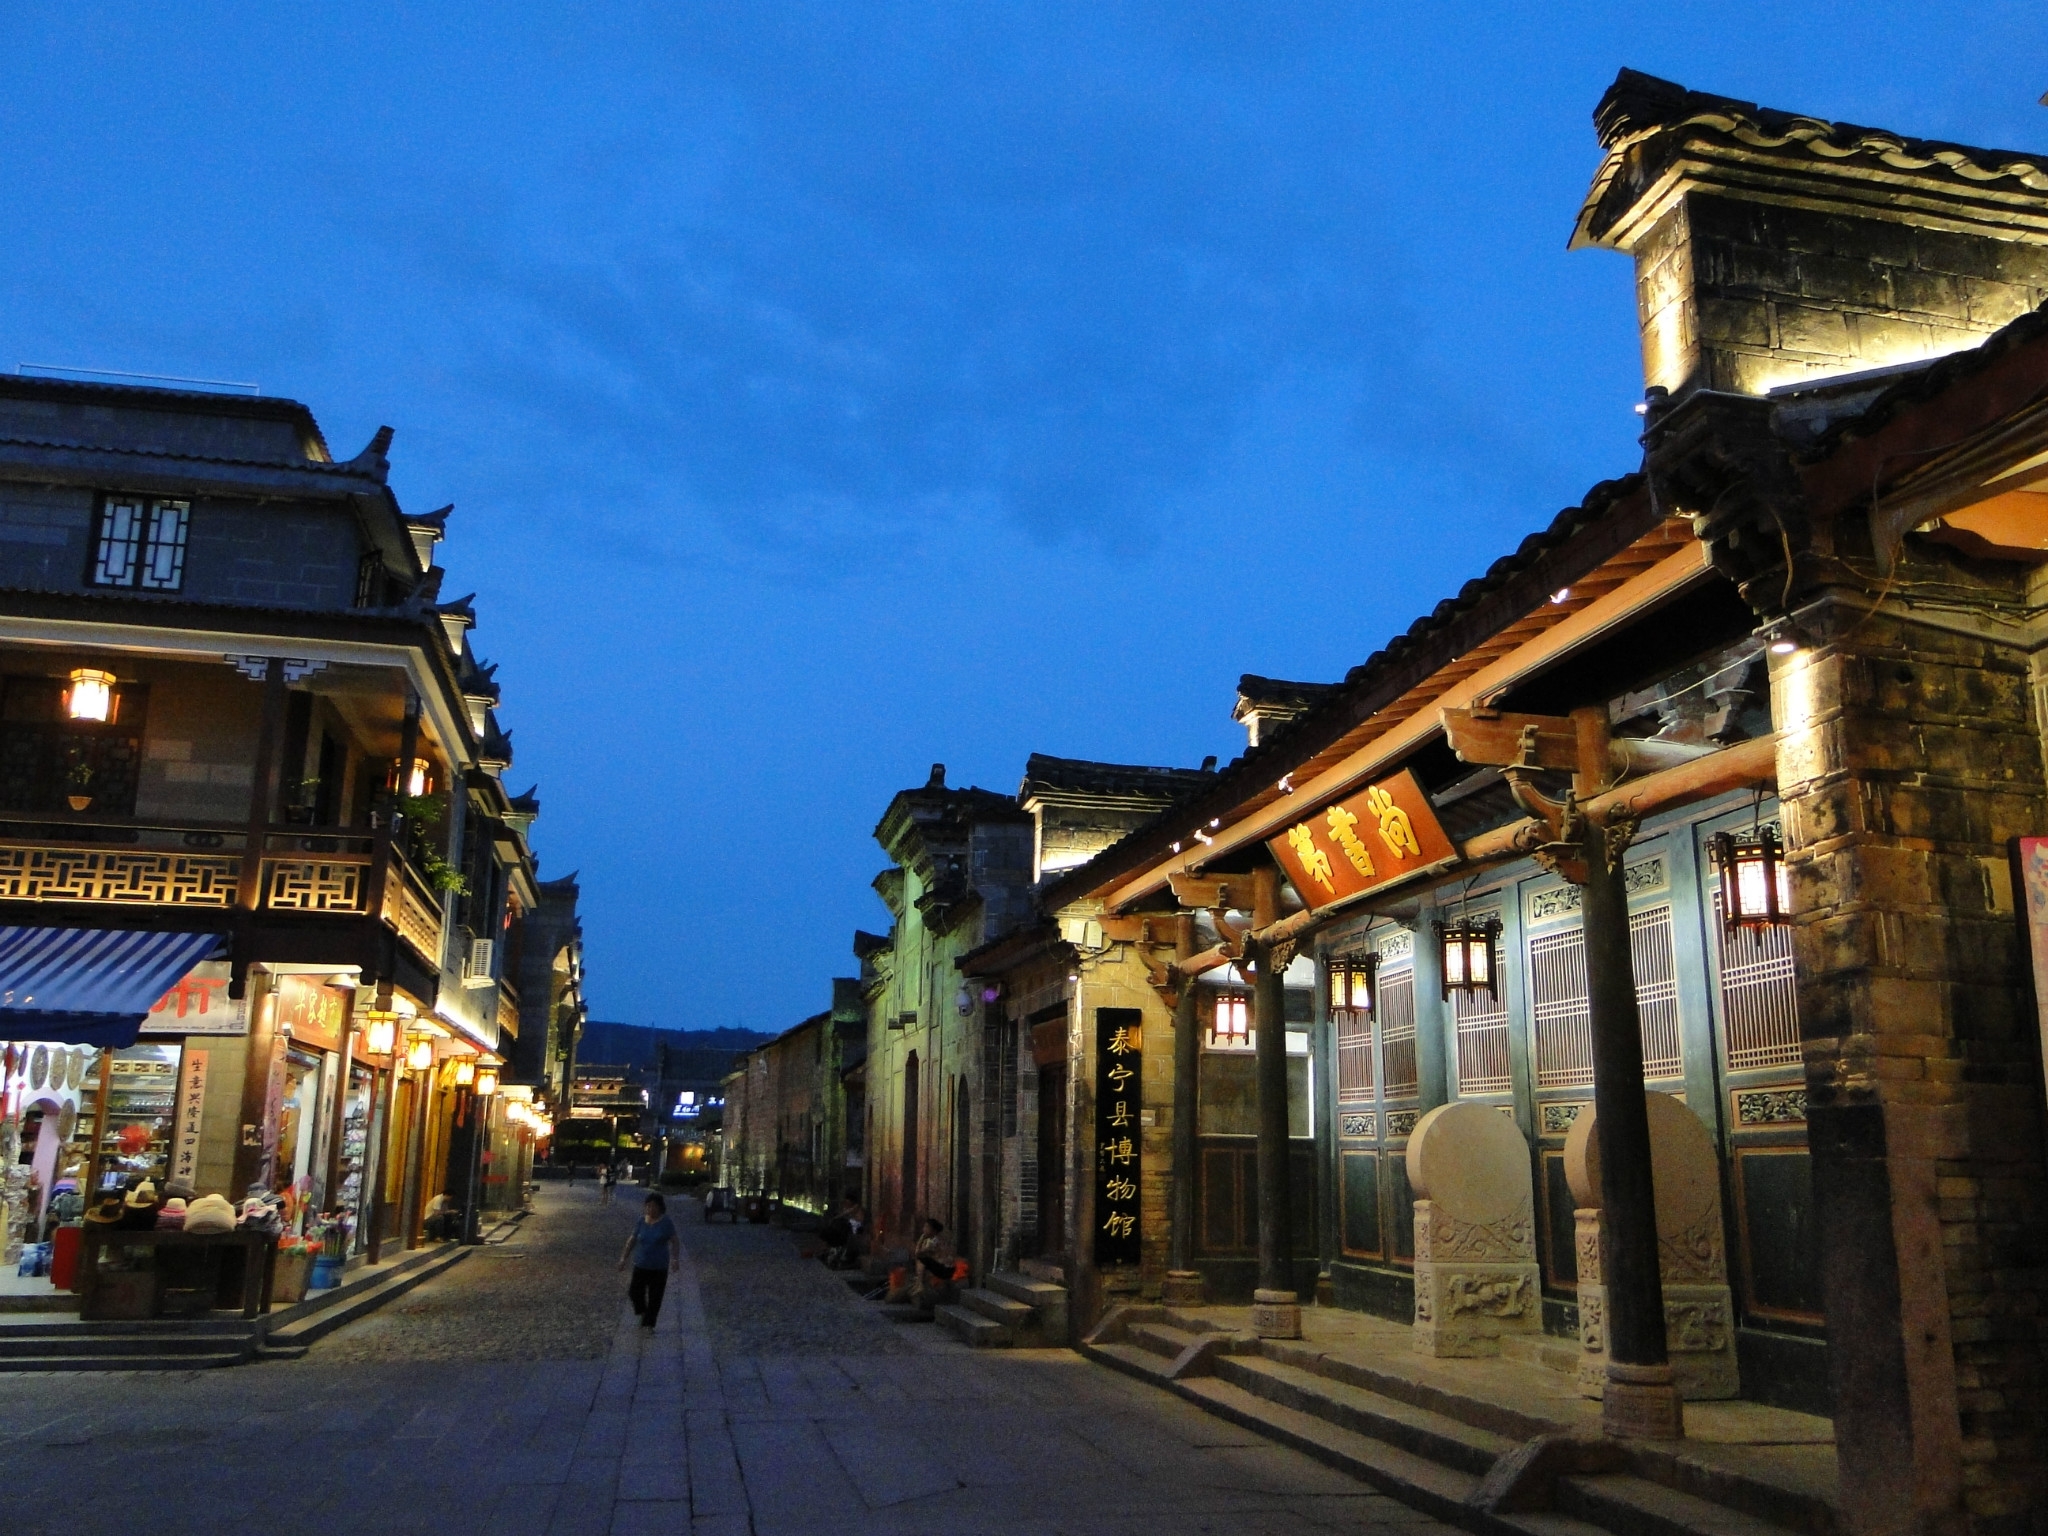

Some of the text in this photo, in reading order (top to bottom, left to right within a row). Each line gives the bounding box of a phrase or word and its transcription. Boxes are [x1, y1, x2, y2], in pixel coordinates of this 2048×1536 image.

[1103, 1026, 1138, 1239] 泰宁县博物馆
